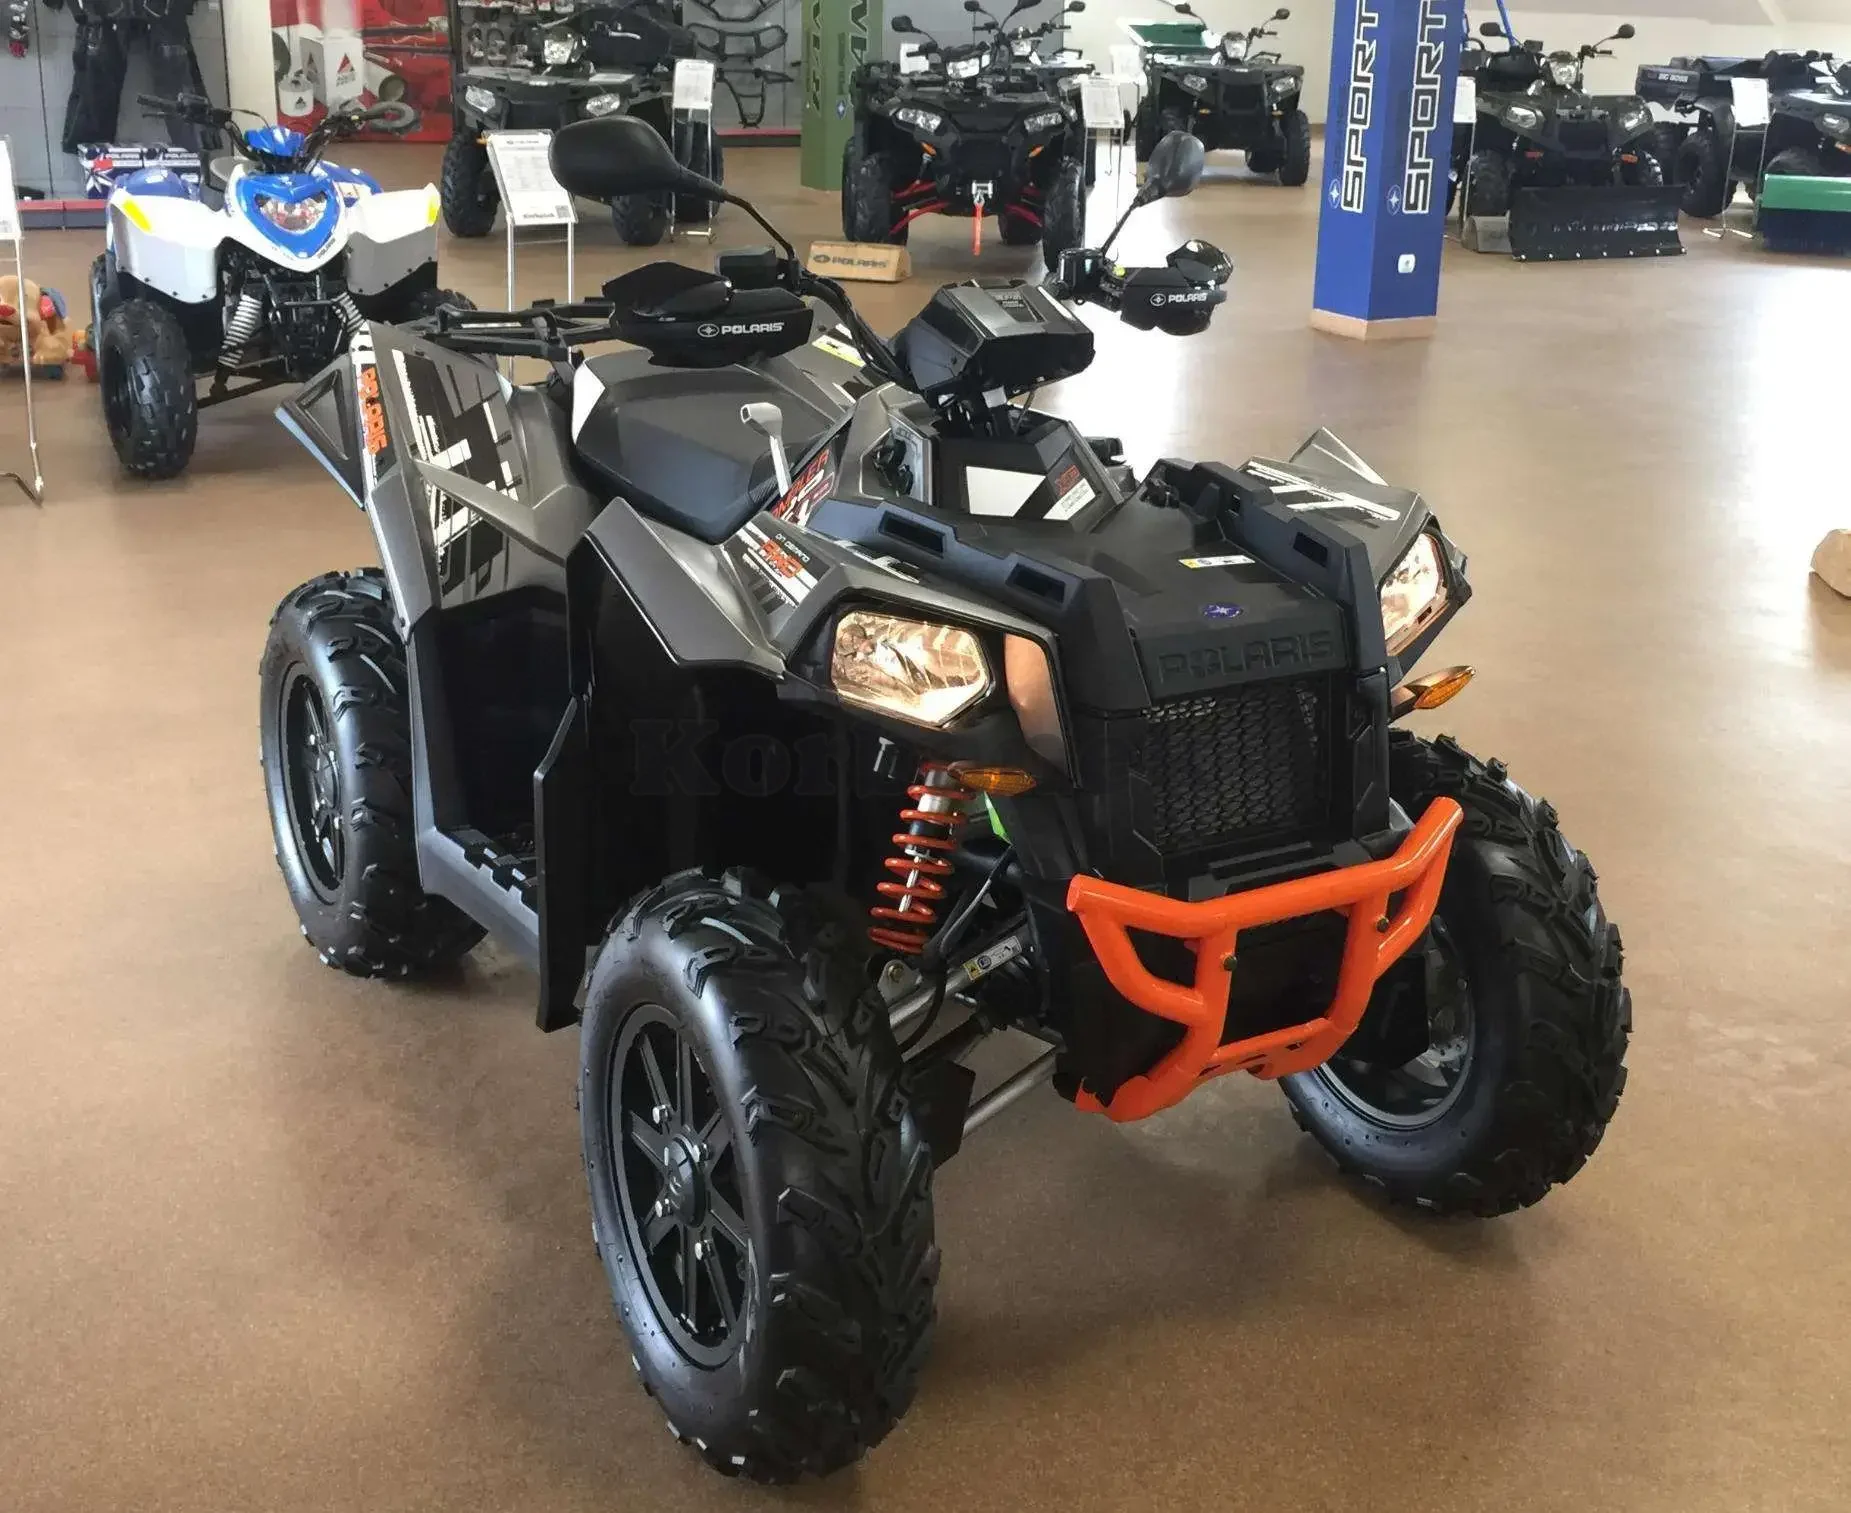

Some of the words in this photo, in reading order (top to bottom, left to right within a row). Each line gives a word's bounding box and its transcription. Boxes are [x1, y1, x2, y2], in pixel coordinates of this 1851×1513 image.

[1341, 0, 1379, 213] SPORT
[1402, 0, 1447, 214] SPORT
[1168, 292, 1208, 304] POLARIS
[721, 322, 785, 335] POLARIS
[1158, 630, 1336, 684] POLARIS
